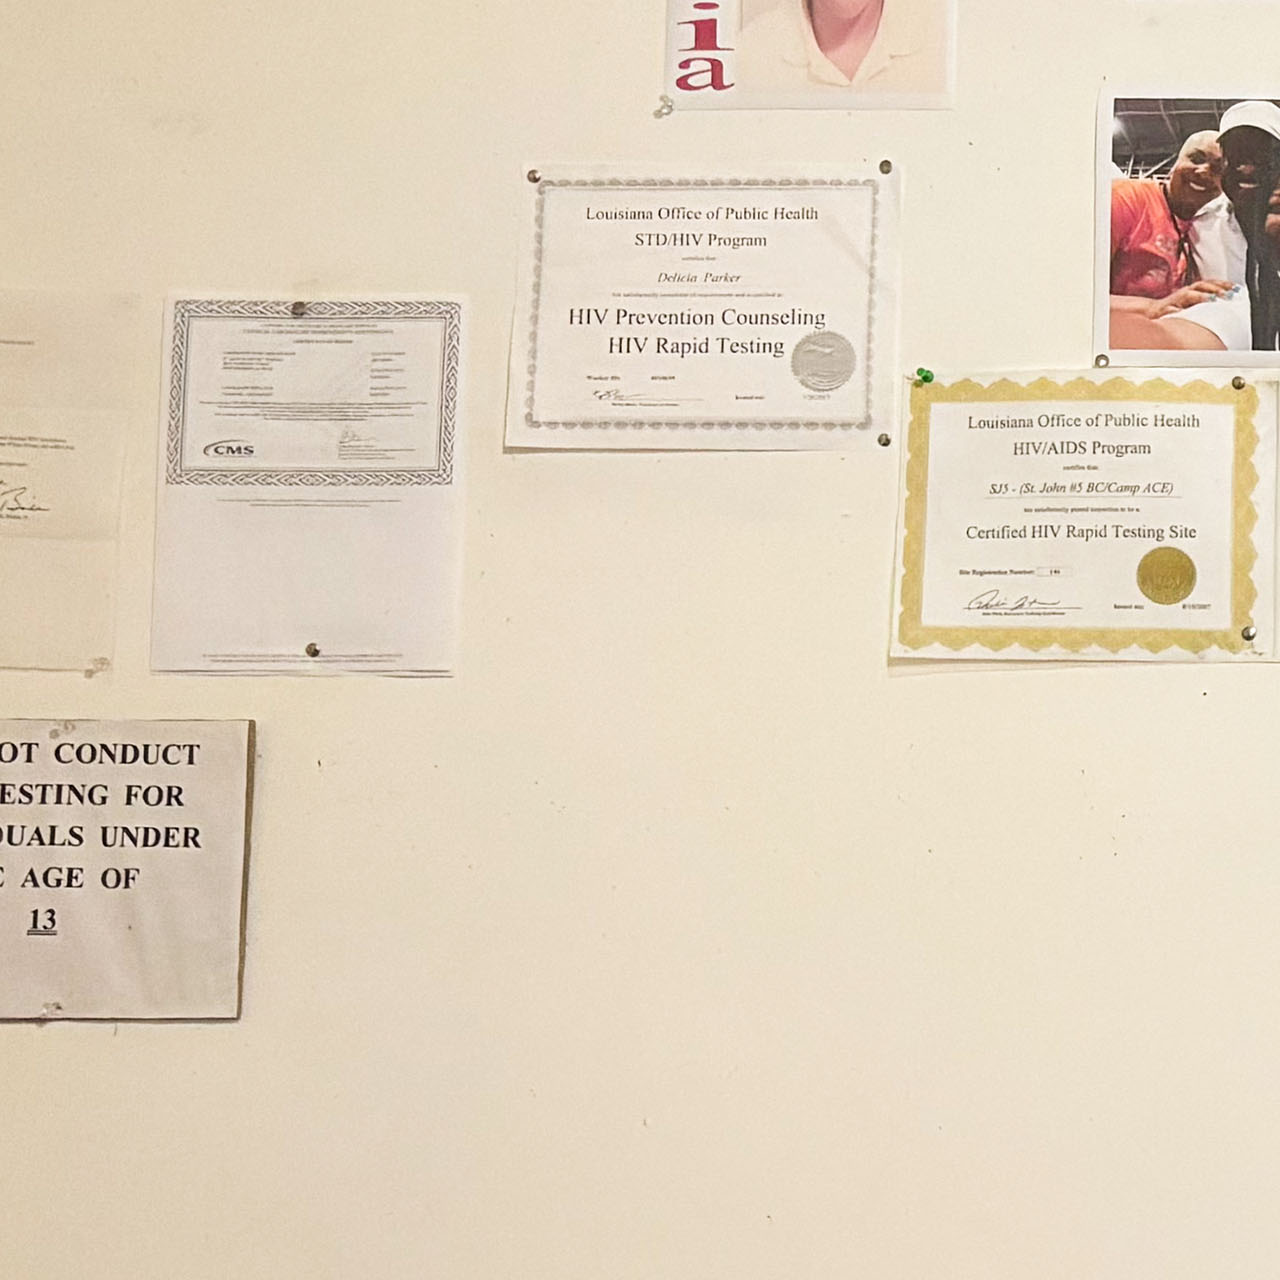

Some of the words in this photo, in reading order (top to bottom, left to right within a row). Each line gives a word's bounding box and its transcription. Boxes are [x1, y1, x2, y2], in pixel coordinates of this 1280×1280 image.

[586, 207, 653, 220] Louisiana
[658, 207, 701, 220] Office
[706, 207, 722, 220] of
[725, 207, 769, 220] Public
[774, 207, 818, 220] Health
[634, 233, 703, 247] STD/HIV
[708, 233, 767, 248] Program
[658, 272, 698, 284] Delicia
[703, 272, 743, 284] Parker
[569, 308, 608, 326] HIV
[616, 308, 715, 326] Prevention
[721, 308, 826, 329] Counseling
[608, 337, 648, 354] HIV
[656, 337, 709, 358] Rapid
[716, 337, 785, 358] Testing
[968, 415, 1034, 429] Louisiana
[1038, 414, 1081, 428] Office
[1085, 414, 1102, 428] of
[1104, 414, 1149, 428] Public
[1153, 414, 1200, 428] Health
[213, 445, 254, 456] CMS
[1013, 441, 1087, 456] HIV/AIDS
[1092, 442, 1151, 458] Program
[989, 483, 1010, 495] SJ5
[1019, 483, 1037, 495] (St.
[1040, 483, 1066, 495] John
[1070, 483, 1083, 495] #5
[1086, 483, 1141, 497] BC/Camp
[1143, 483, 1174, 495] ACE)
[966, 525, 1027, 540] Certified
[1031, 525, 1061, 540] HIV
[1066, 525, 1108, 542] Rapid
[1112, 525, 1165, 542] Testing
[1169, 525, 1197, 540] Site
[54, 742, 200, 765] CONDUCT
[125, 785, 184, 806] FOR
[0, 825, 84, 847] UALS
[100, 826, 201, 848] UNDER
[20, 867, 84, 889] AGE
[100, 867, 140, 889] OF
[29, 908, 56, 931] 13
